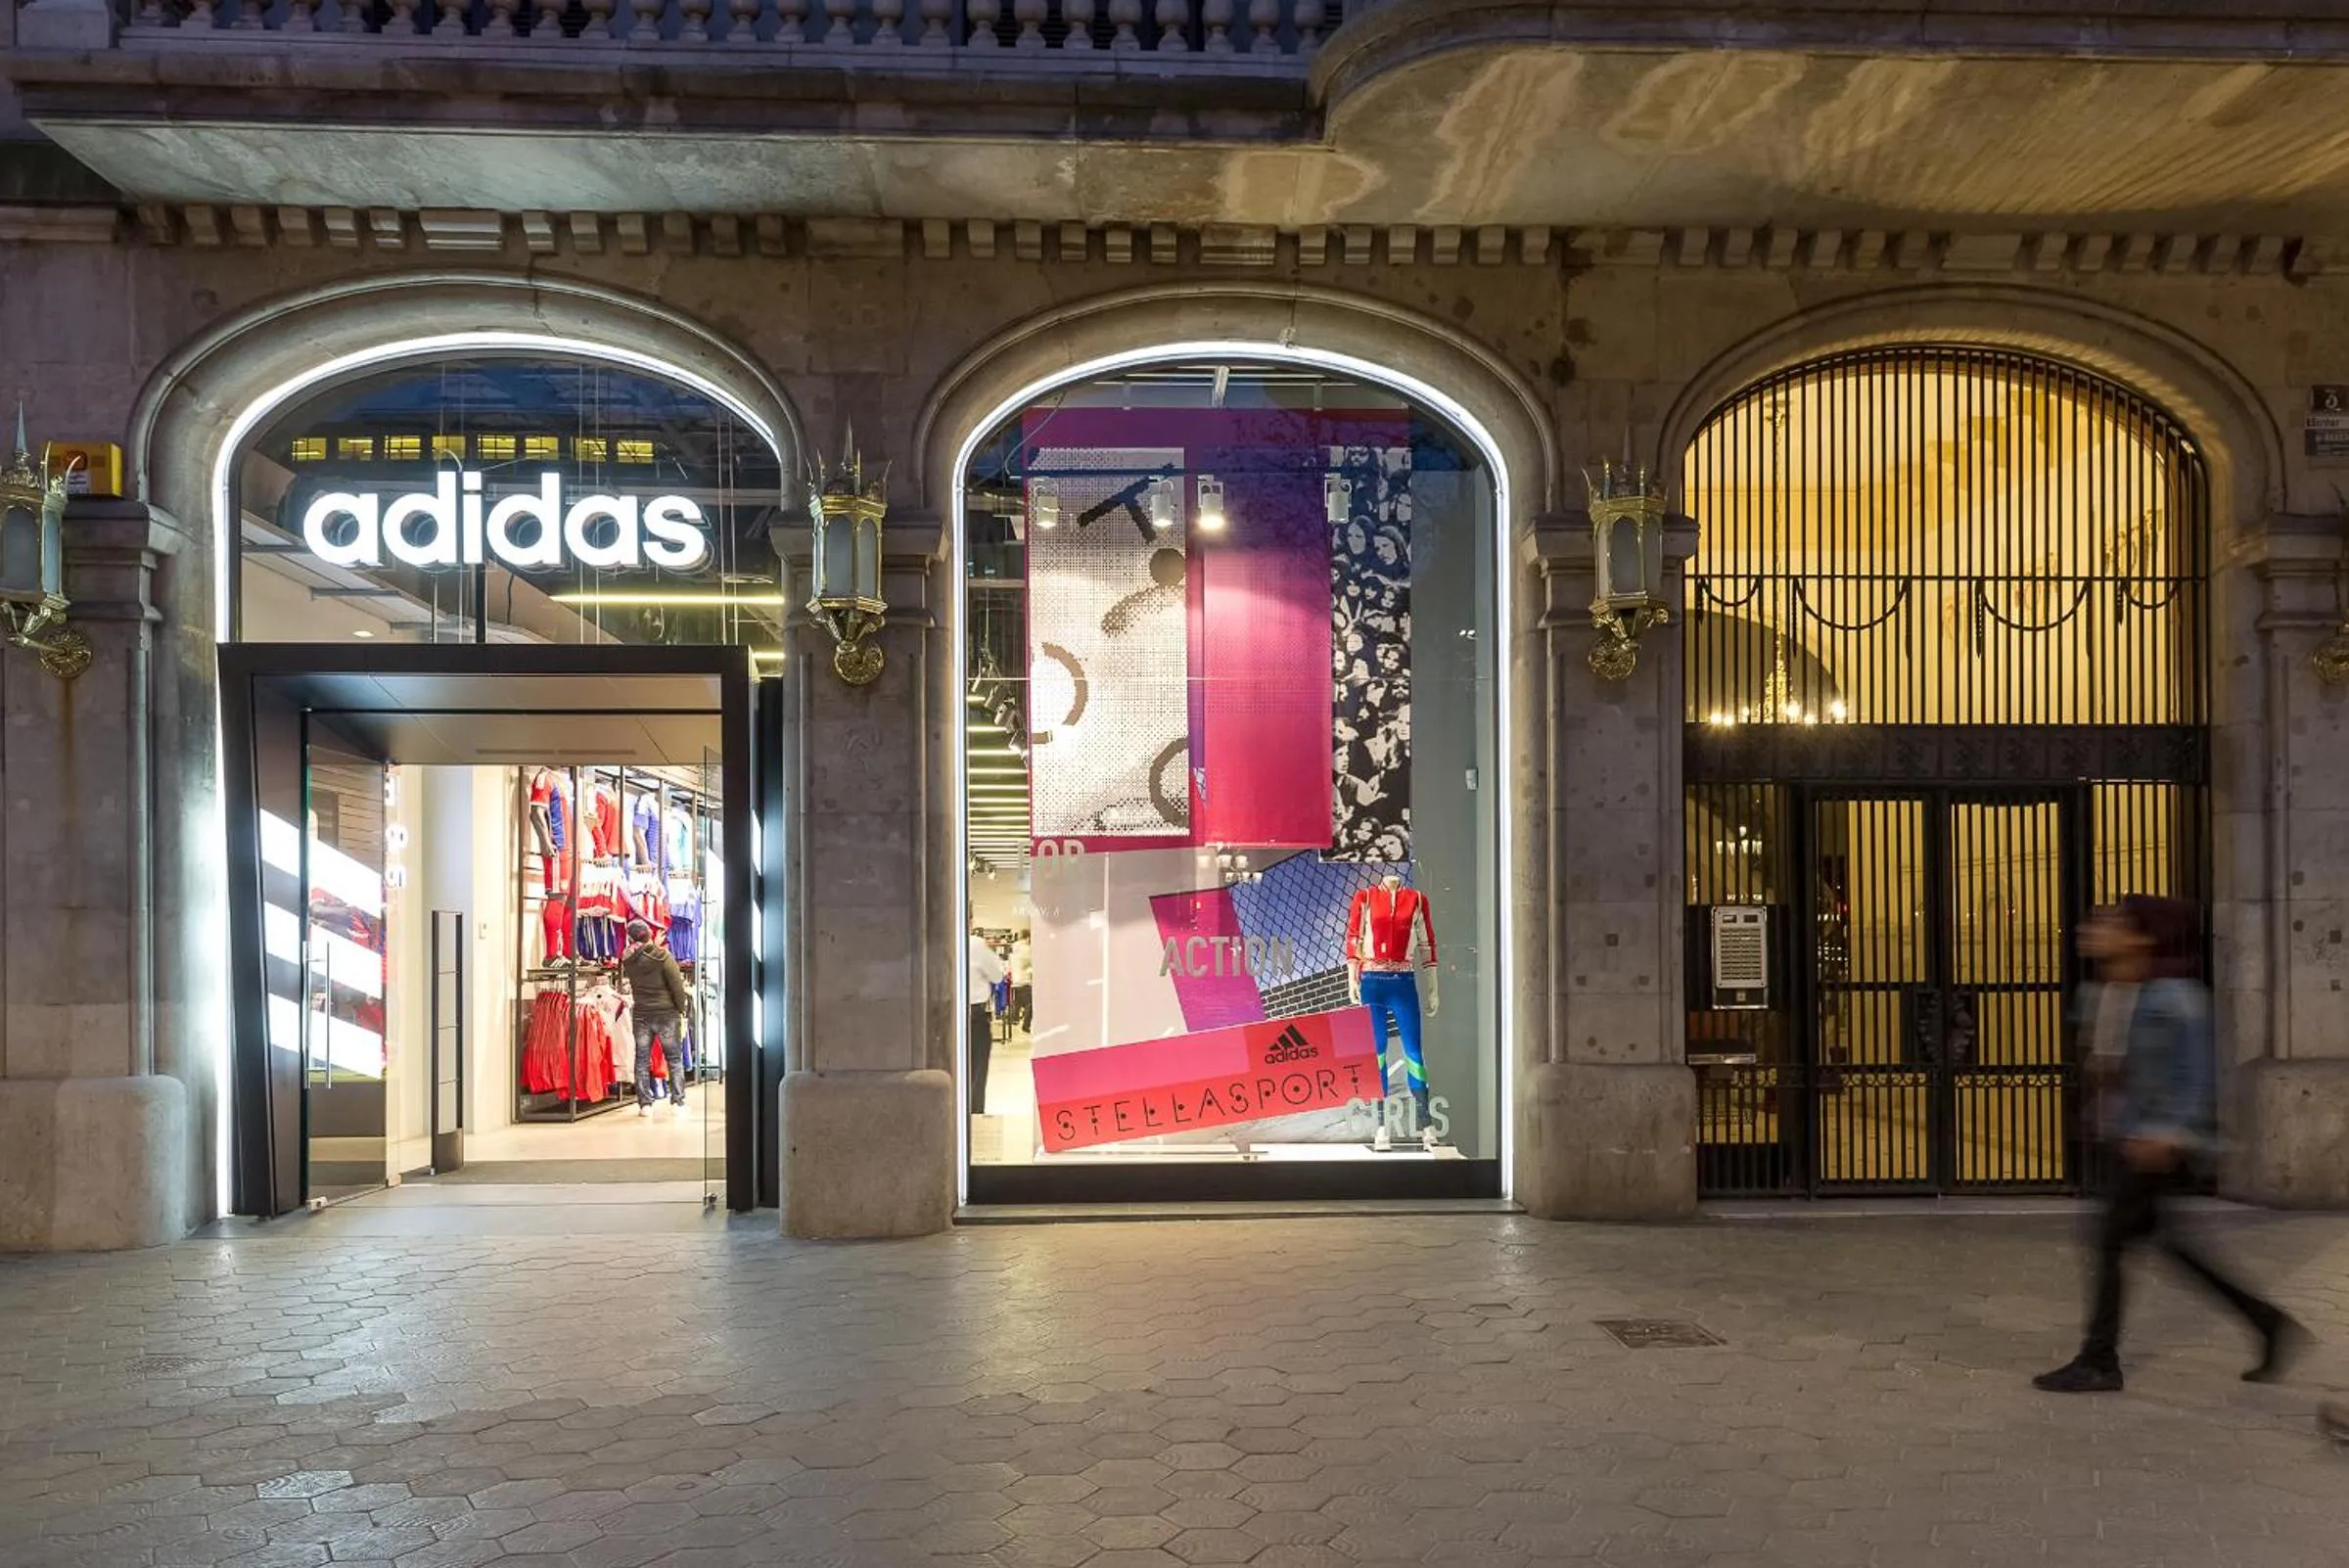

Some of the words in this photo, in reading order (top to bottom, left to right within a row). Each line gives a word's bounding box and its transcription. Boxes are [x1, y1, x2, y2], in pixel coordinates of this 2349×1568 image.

[303, 471, 707, 568] adidas
[1017, 839, 1085, 880] FOR
[1159, 935, 1294, 978] ACTION
[1265, 1045, 1319, 1065] adidas
[1055, 1063, 1364, 1141] STELLASPORT
[1346, 1095, 1450, 1138] GIRLS
